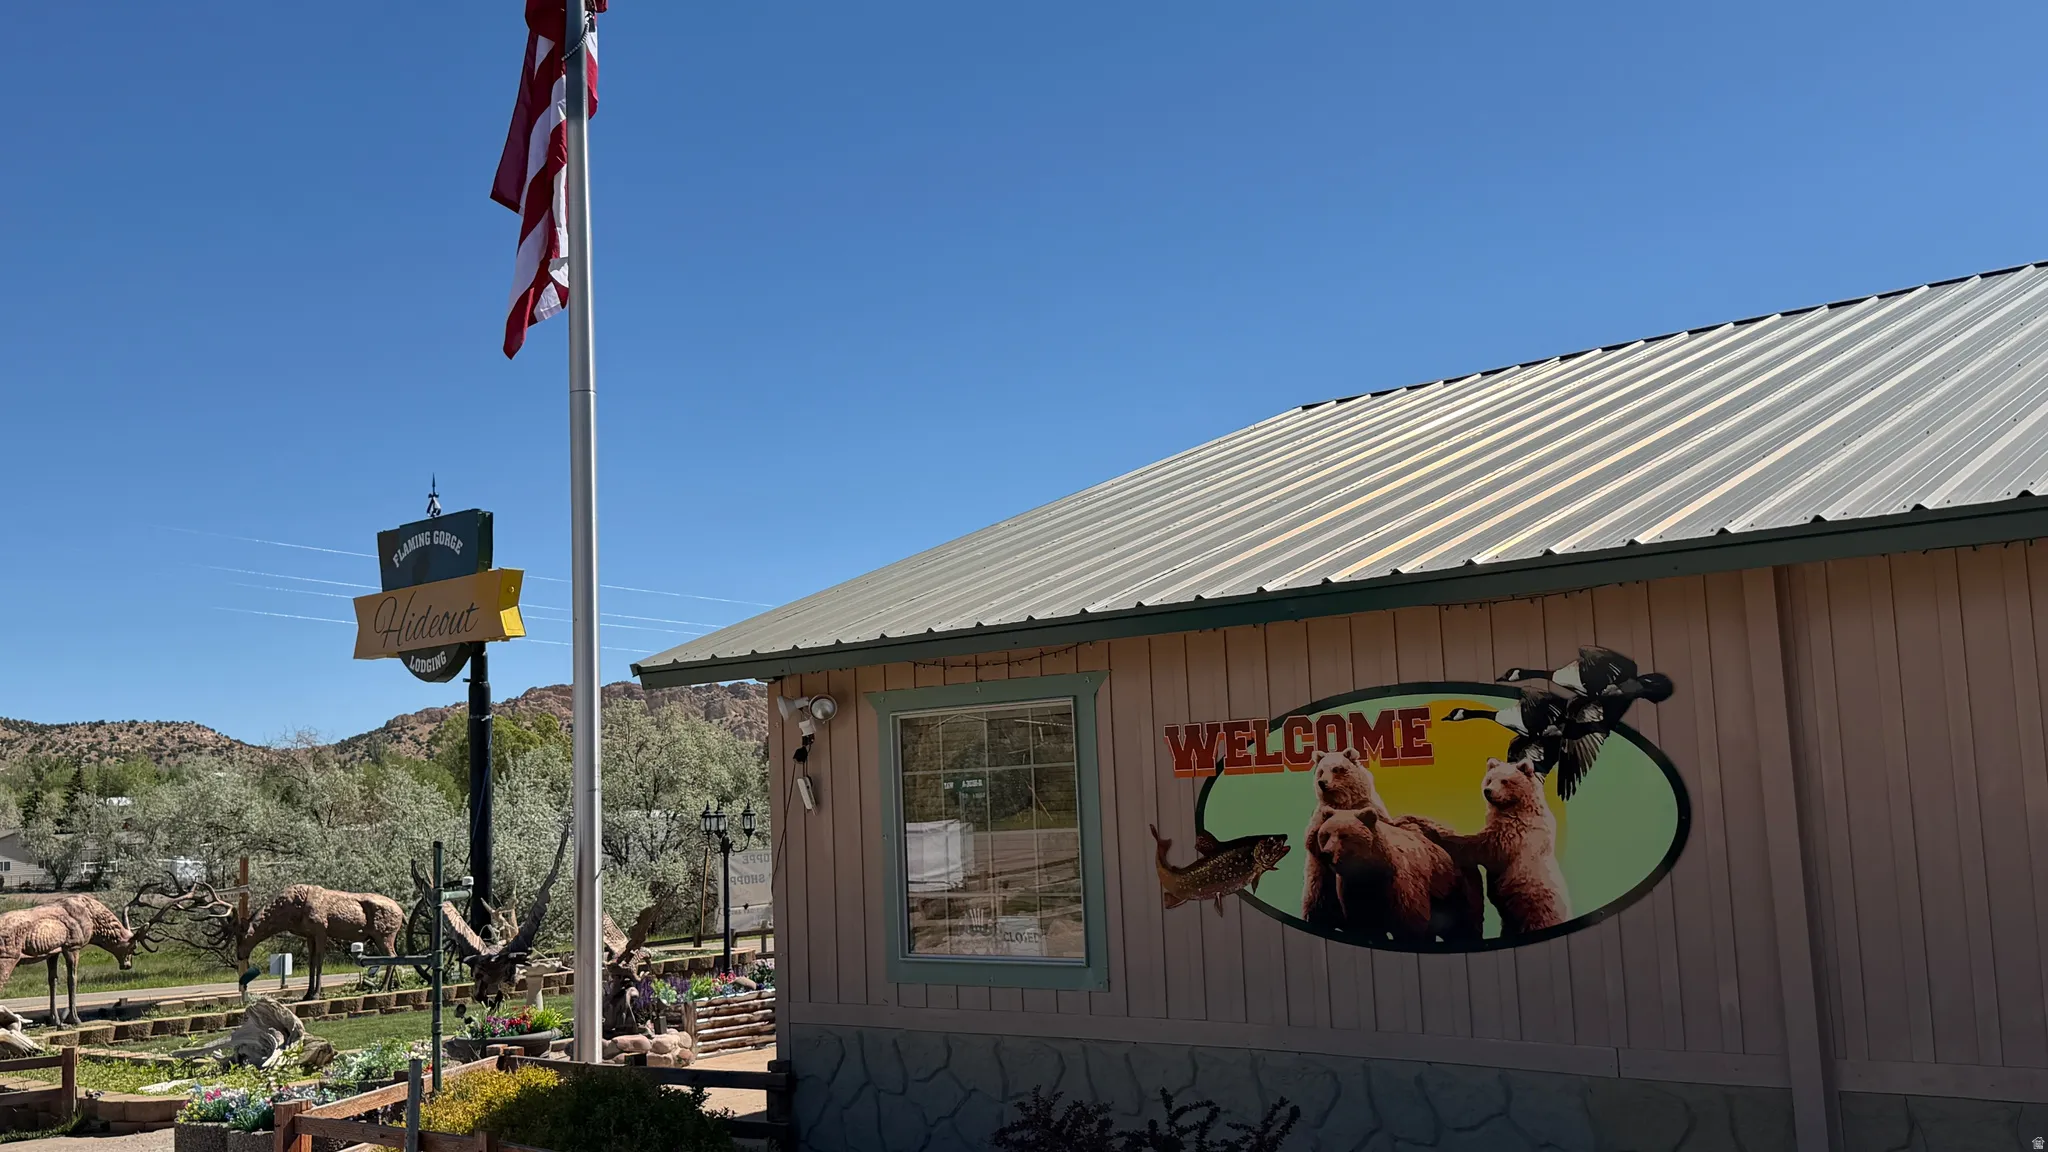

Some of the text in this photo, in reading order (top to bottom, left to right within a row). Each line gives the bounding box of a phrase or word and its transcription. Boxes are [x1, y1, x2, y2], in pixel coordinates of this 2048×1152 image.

[392, 530, 463, 568] FLAMING GORGE
[374, 590, 479, 649] Hideout
[409, 650, 447, 674] LODGING
[1164, 706, 1434, 778] WELCOME
